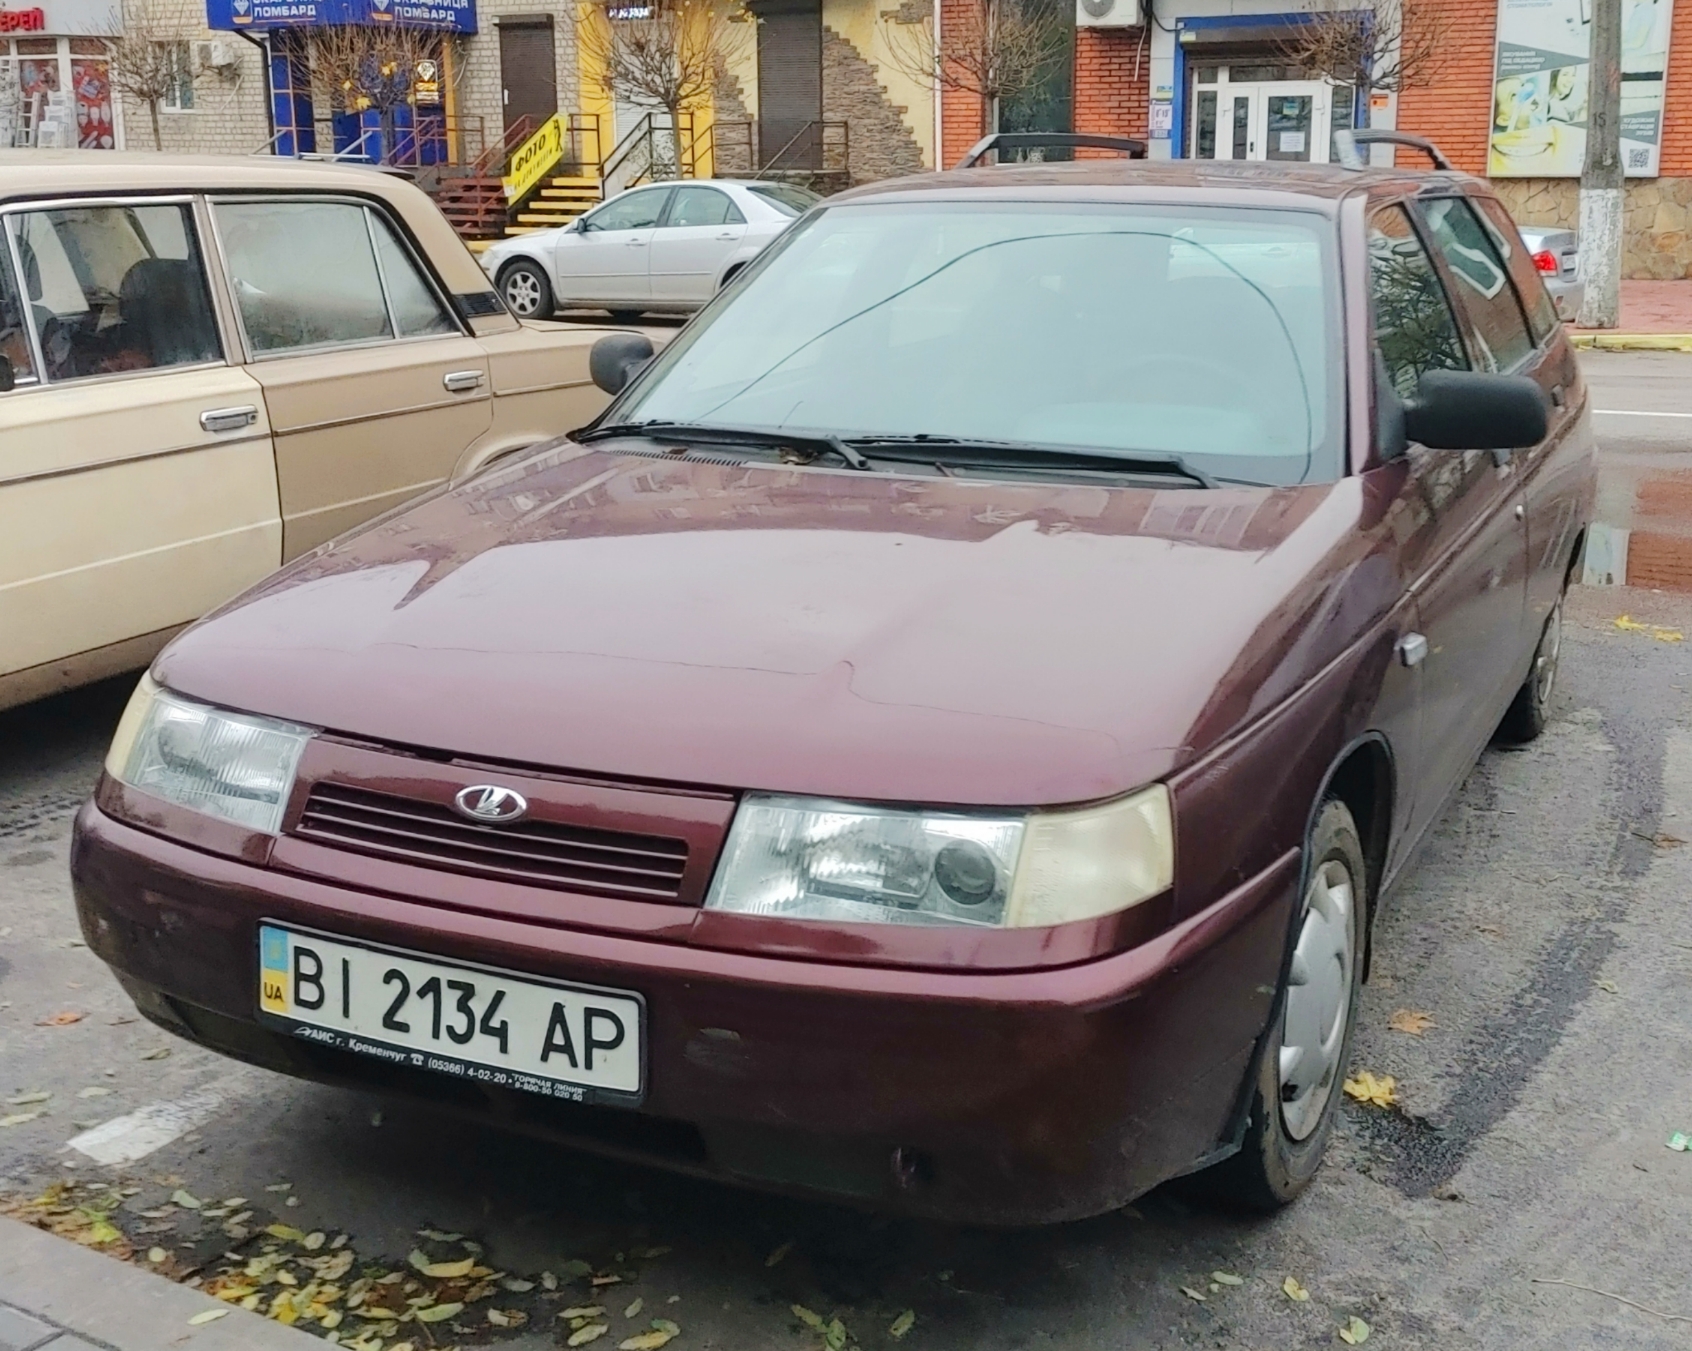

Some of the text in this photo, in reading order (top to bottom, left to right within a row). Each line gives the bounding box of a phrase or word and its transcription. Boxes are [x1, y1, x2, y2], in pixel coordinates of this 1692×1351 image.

[254, 4, 317, 17] ЛОМБАРД
[395, 6, 456, 21] ЛОМБАРД
[515, 134, 546, 172] ФОТО
[264, 982, 284, 1002] UA
[294, 945, 625, 1071] BI 2134 AP
[310, 1029, 507, 1084] АИС г. Кременчуг (05366) 4-02-20
